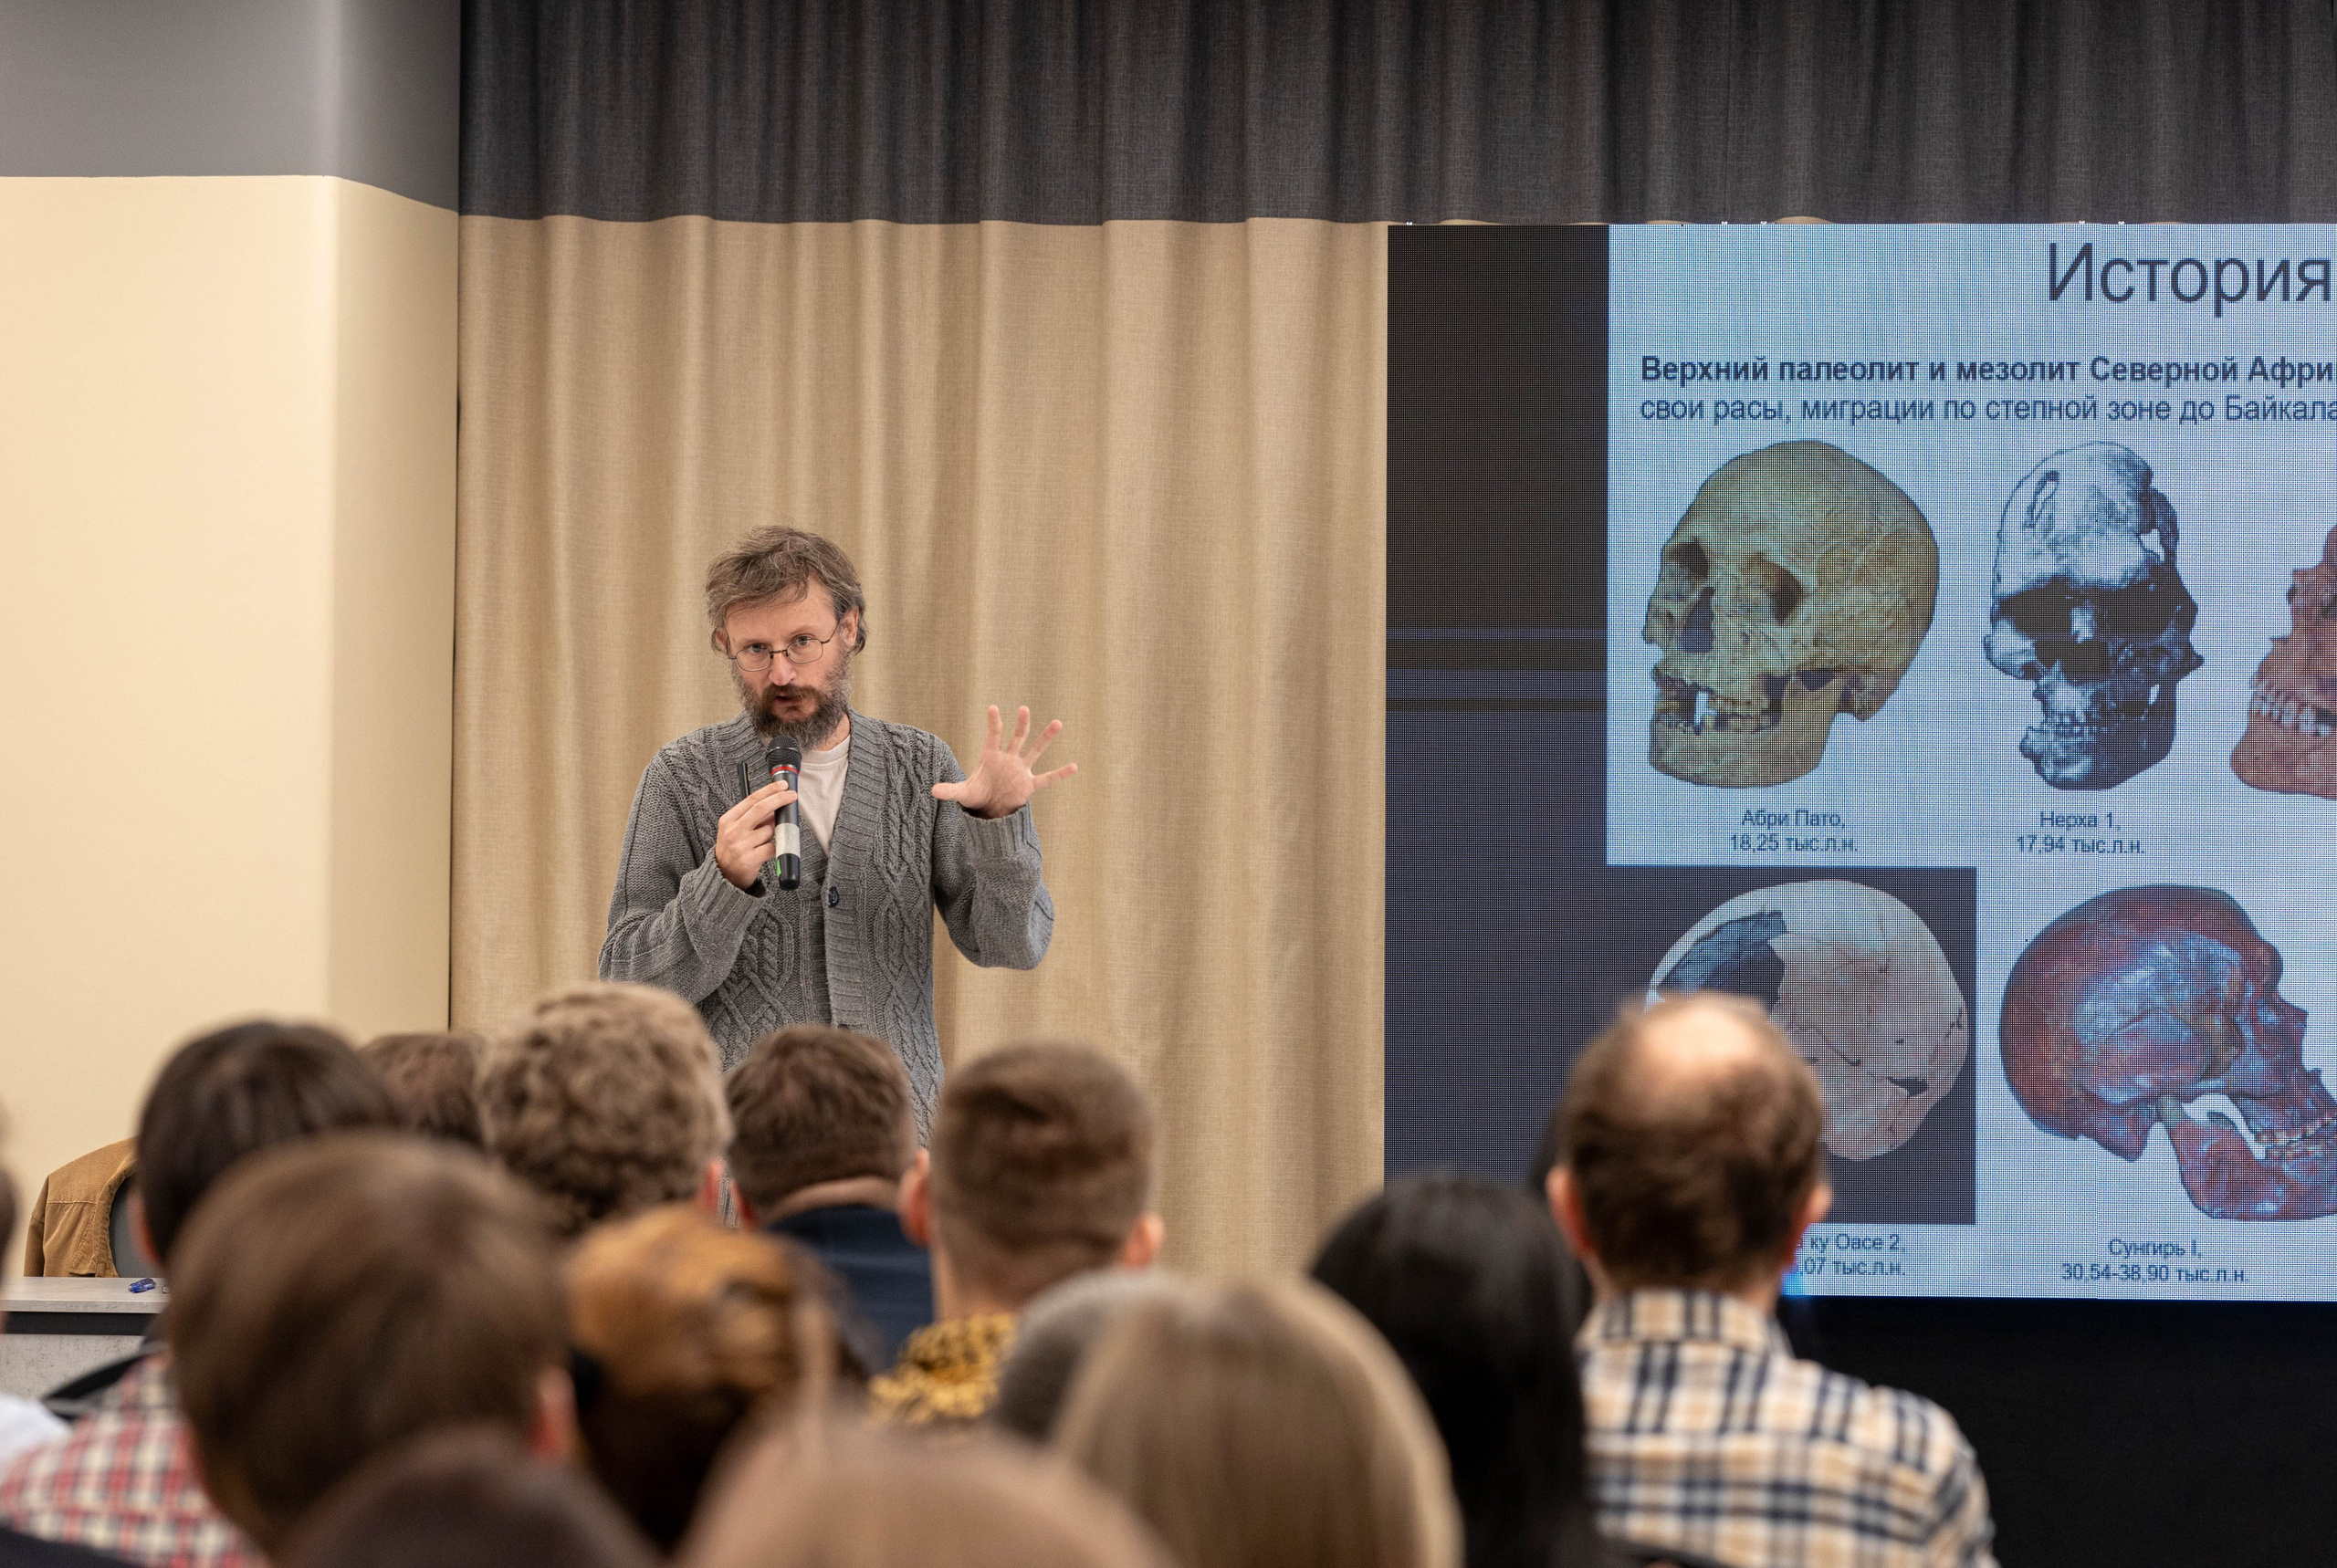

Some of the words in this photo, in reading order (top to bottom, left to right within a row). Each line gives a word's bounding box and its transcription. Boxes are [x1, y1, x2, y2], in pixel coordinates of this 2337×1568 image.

[2049, 242, 2331, 318] История
[1641, 355, 1768, 388] Верхний
[1780, 361, 1920, 382] палеолит
[1929, 361, 1946, 382] и
[1956, 361, 2080, 382] мезолит
[2090, 355, 2237, 389] Северной
[2248, 355, 2337, 389] Афри
[1640, 399, 1704, 421] свои
[1713, 399, 1791, 426] расы,
[1800, 399, 1934, 426] миграции
[1944, 399, 1976, 421] по
[1986, 394, 2098, 421] степной
[2107, 399, 2171, 422] зоне
[2178, 400, 2216, 425] до
[2225, 394, 2337, 422] Байкала
[1741, 808, 1789, 830] Абри
[1795, 809, 1846, 830] Пато,
[2039, 810, 2099, 831] Нерха
[2106, 810, 2122, 831] 1,
[1730, 832, 1780, 853] 18,25
[1785, 837, 1859, 852] тыс.л.н.
[2016, 834, 2065, 855] 17,94
[2070, 838, 2146, 855] тыс.л.н.
[1834, 1232, 1884, 1251] Оасе
[1889, 1232, 1906, 1254] 2,
[2107, 1238, 2186, 1260] Сунгирь
[1832, 1260, 1907, 1277] тыс.л.н.
[2061, 1262, 2170, 1284] 30,54-38,90
